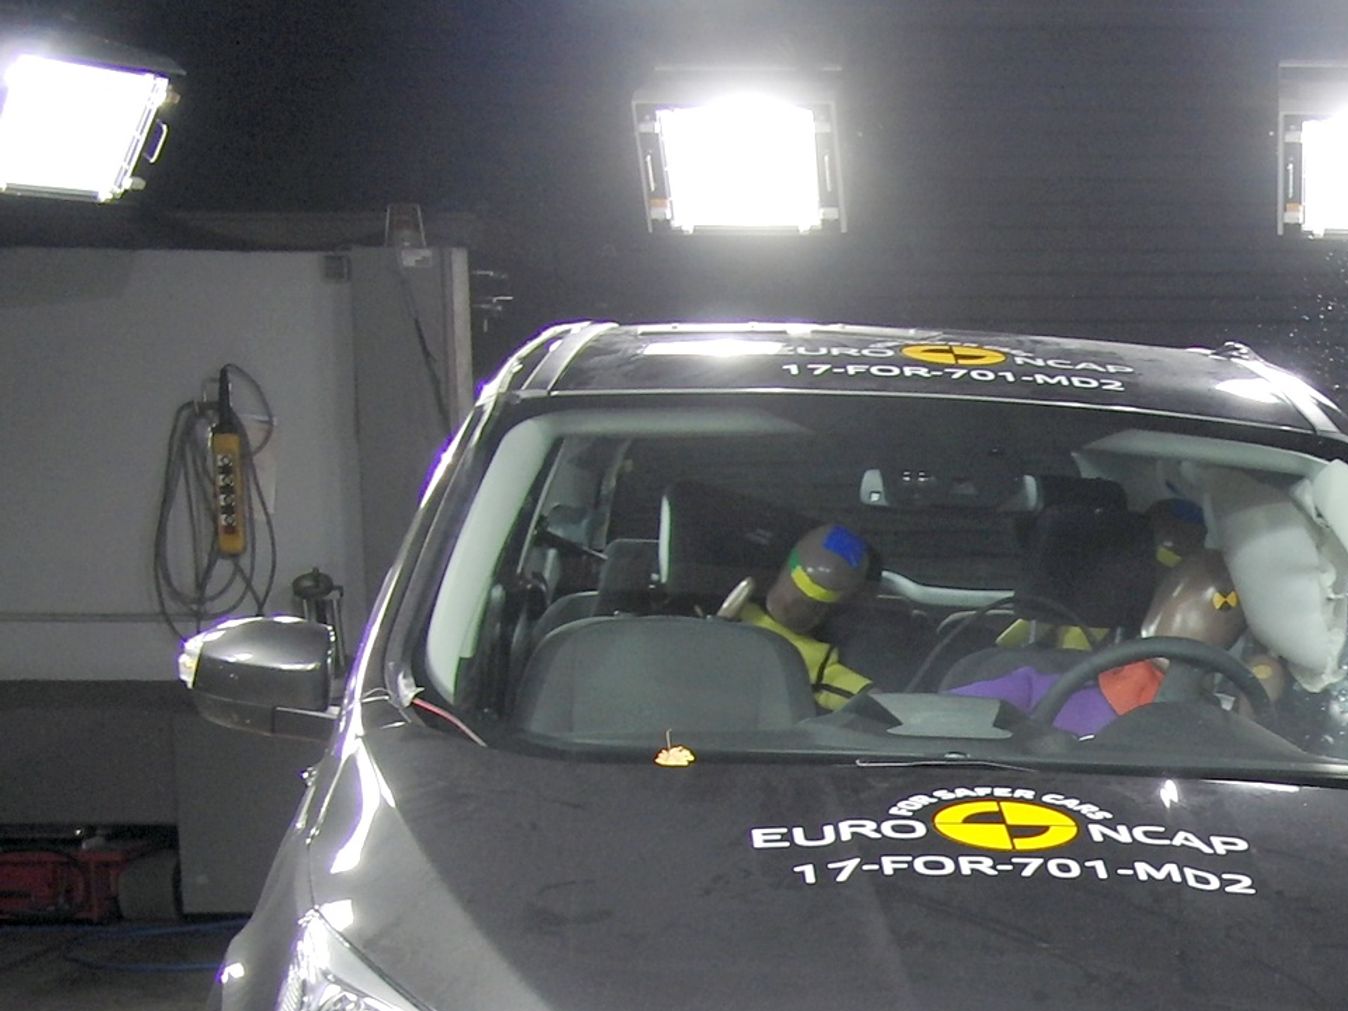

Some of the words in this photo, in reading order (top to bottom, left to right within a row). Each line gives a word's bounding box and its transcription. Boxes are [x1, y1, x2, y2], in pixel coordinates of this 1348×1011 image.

[781, 363, 1126, 391] 17-FOR-701-MD2
[1015, 355, 1134, 374] NCAP
[888, 794, 938, 816] FOR
[933, 787, 1036, 800] SAFER
[1041, 793, 1114, 820] CARS
[750, 819, 928, 849] EURO
[1088, 824, 1249, 855] NCAP
[793, 855, 1257, 895] 17-FOR-701-MD2
